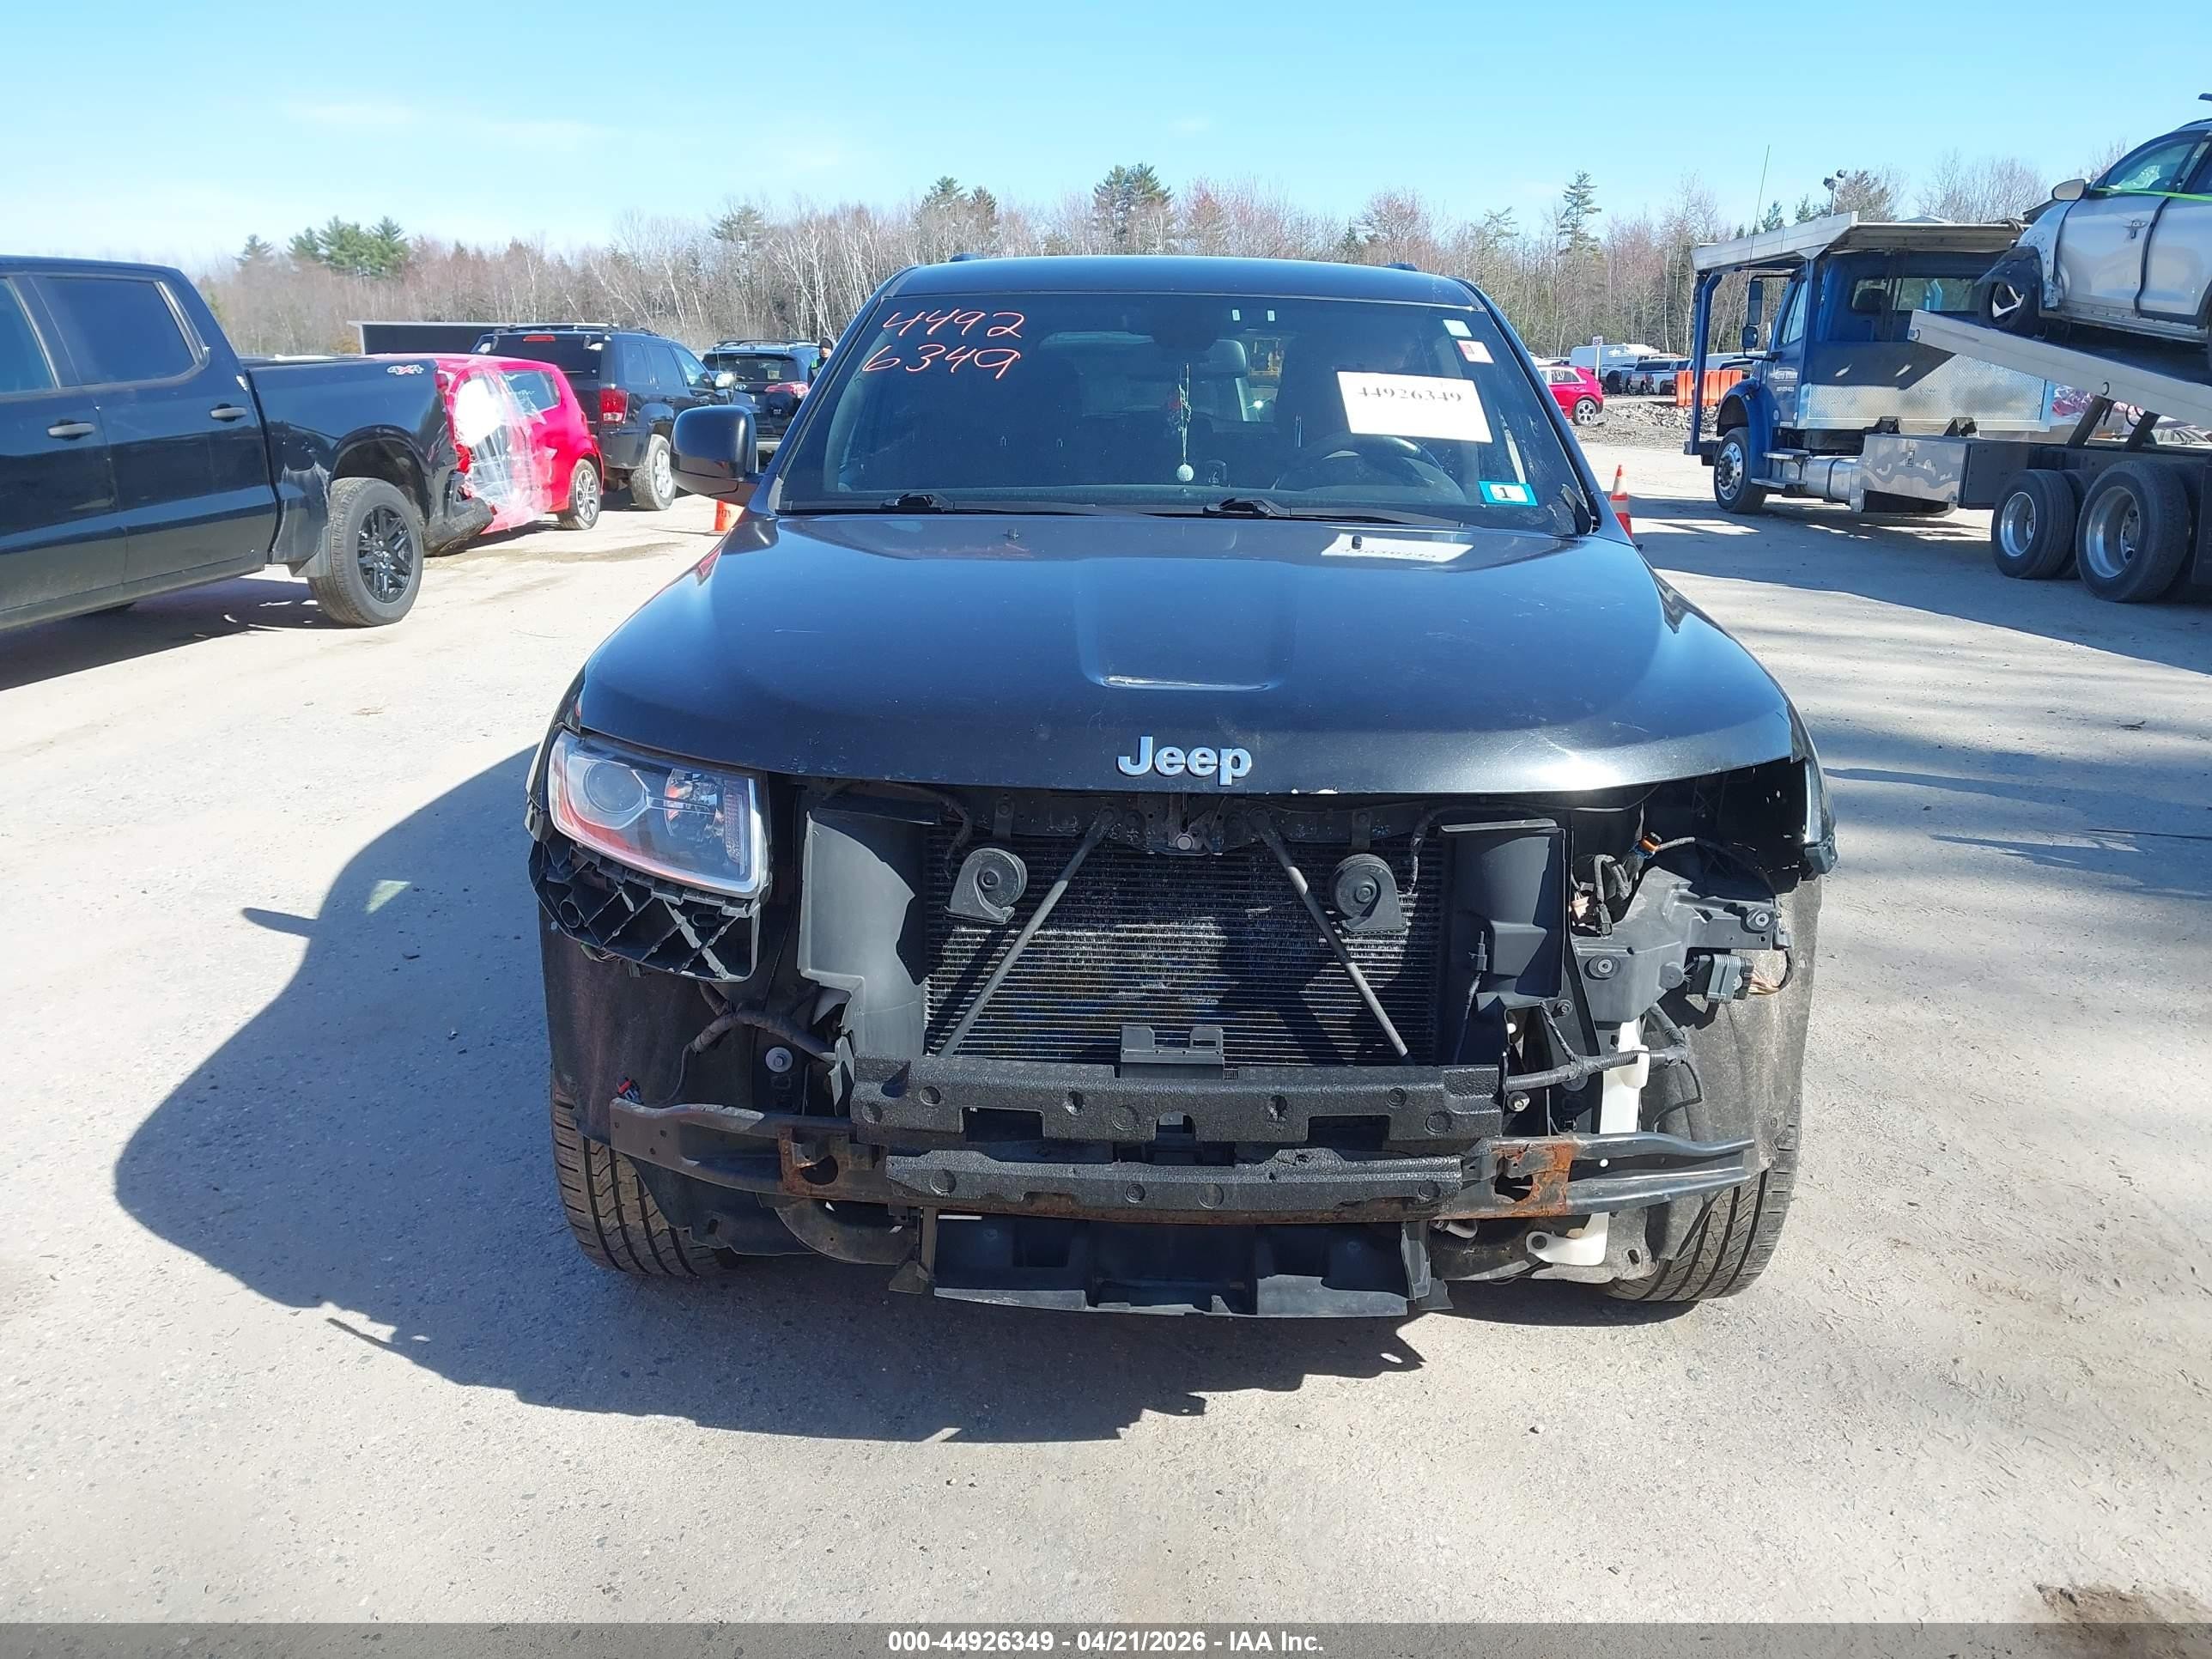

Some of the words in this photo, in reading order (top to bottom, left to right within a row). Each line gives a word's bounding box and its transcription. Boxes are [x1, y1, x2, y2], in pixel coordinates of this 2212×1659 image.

[882, 307, 1025, 338] 4492
[862, 343, 1022, 380] 6349
[1357, 386, 1463, 403] 44926349
[1116, 735, 1253, 787] Jeep
